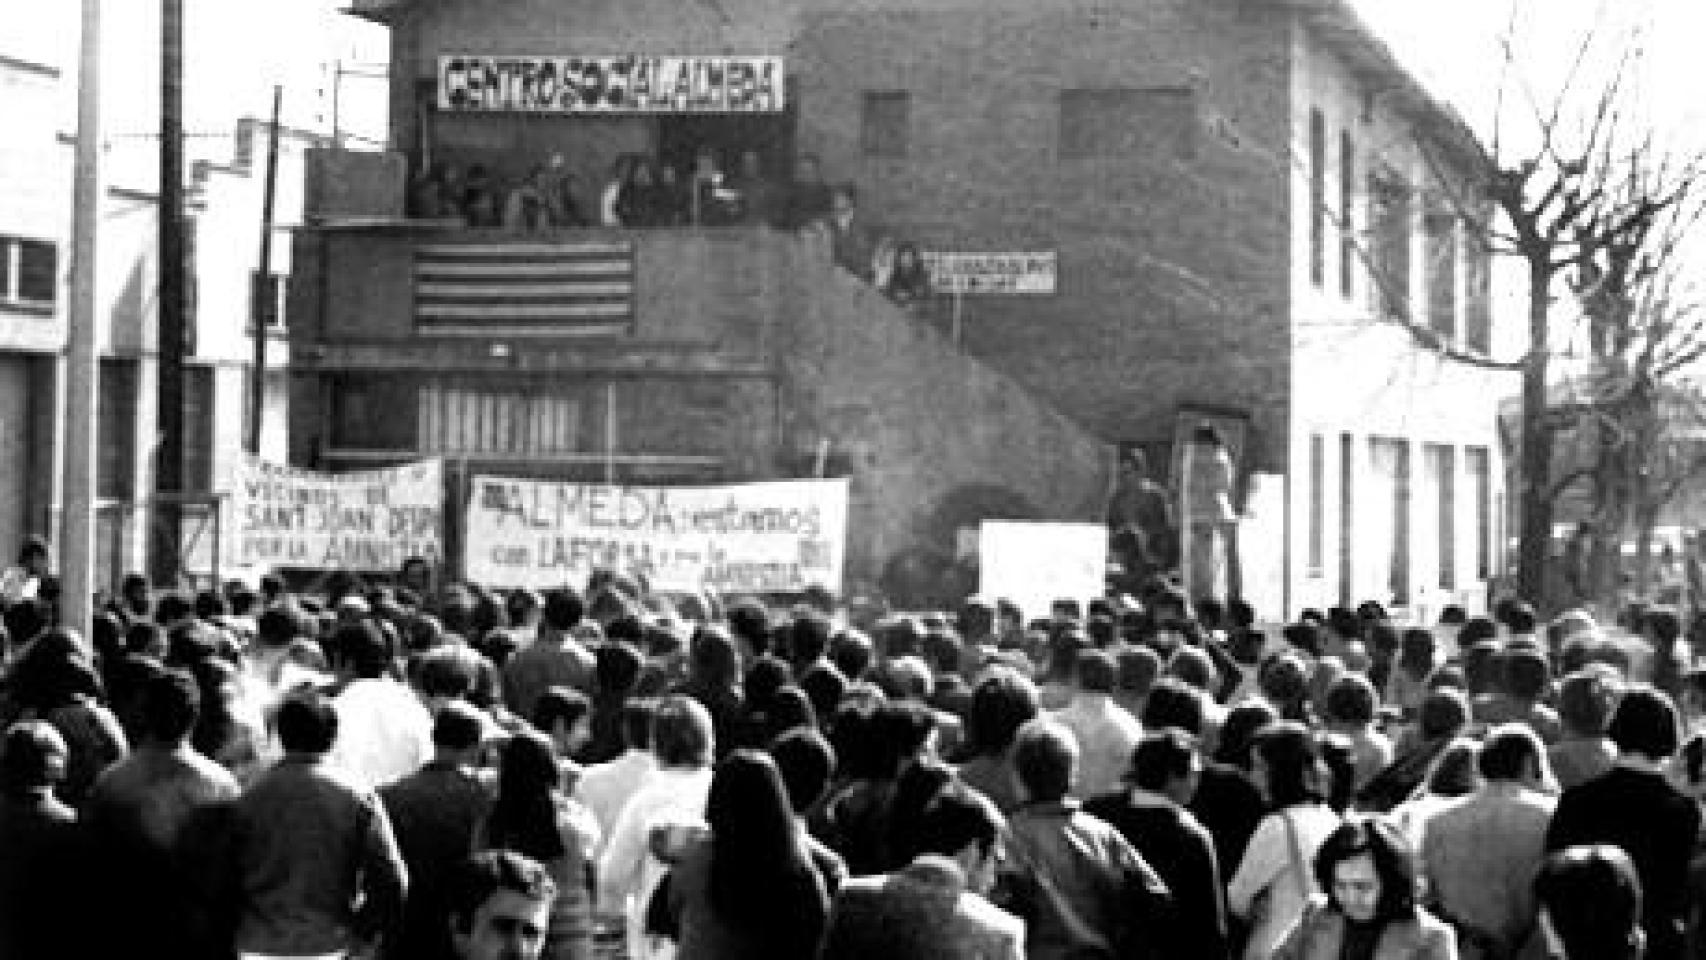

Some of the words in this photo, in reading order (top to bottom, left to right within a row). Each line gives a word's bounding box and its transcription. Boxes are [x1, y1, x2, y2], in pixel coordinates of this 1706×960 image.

[446, 57, 555, 108] CENTRO
[558, 55, 668, 108] SOCIAL
[670, 57, 776, 108] ALMEDA
[245, 504, 306, 532] SANT
